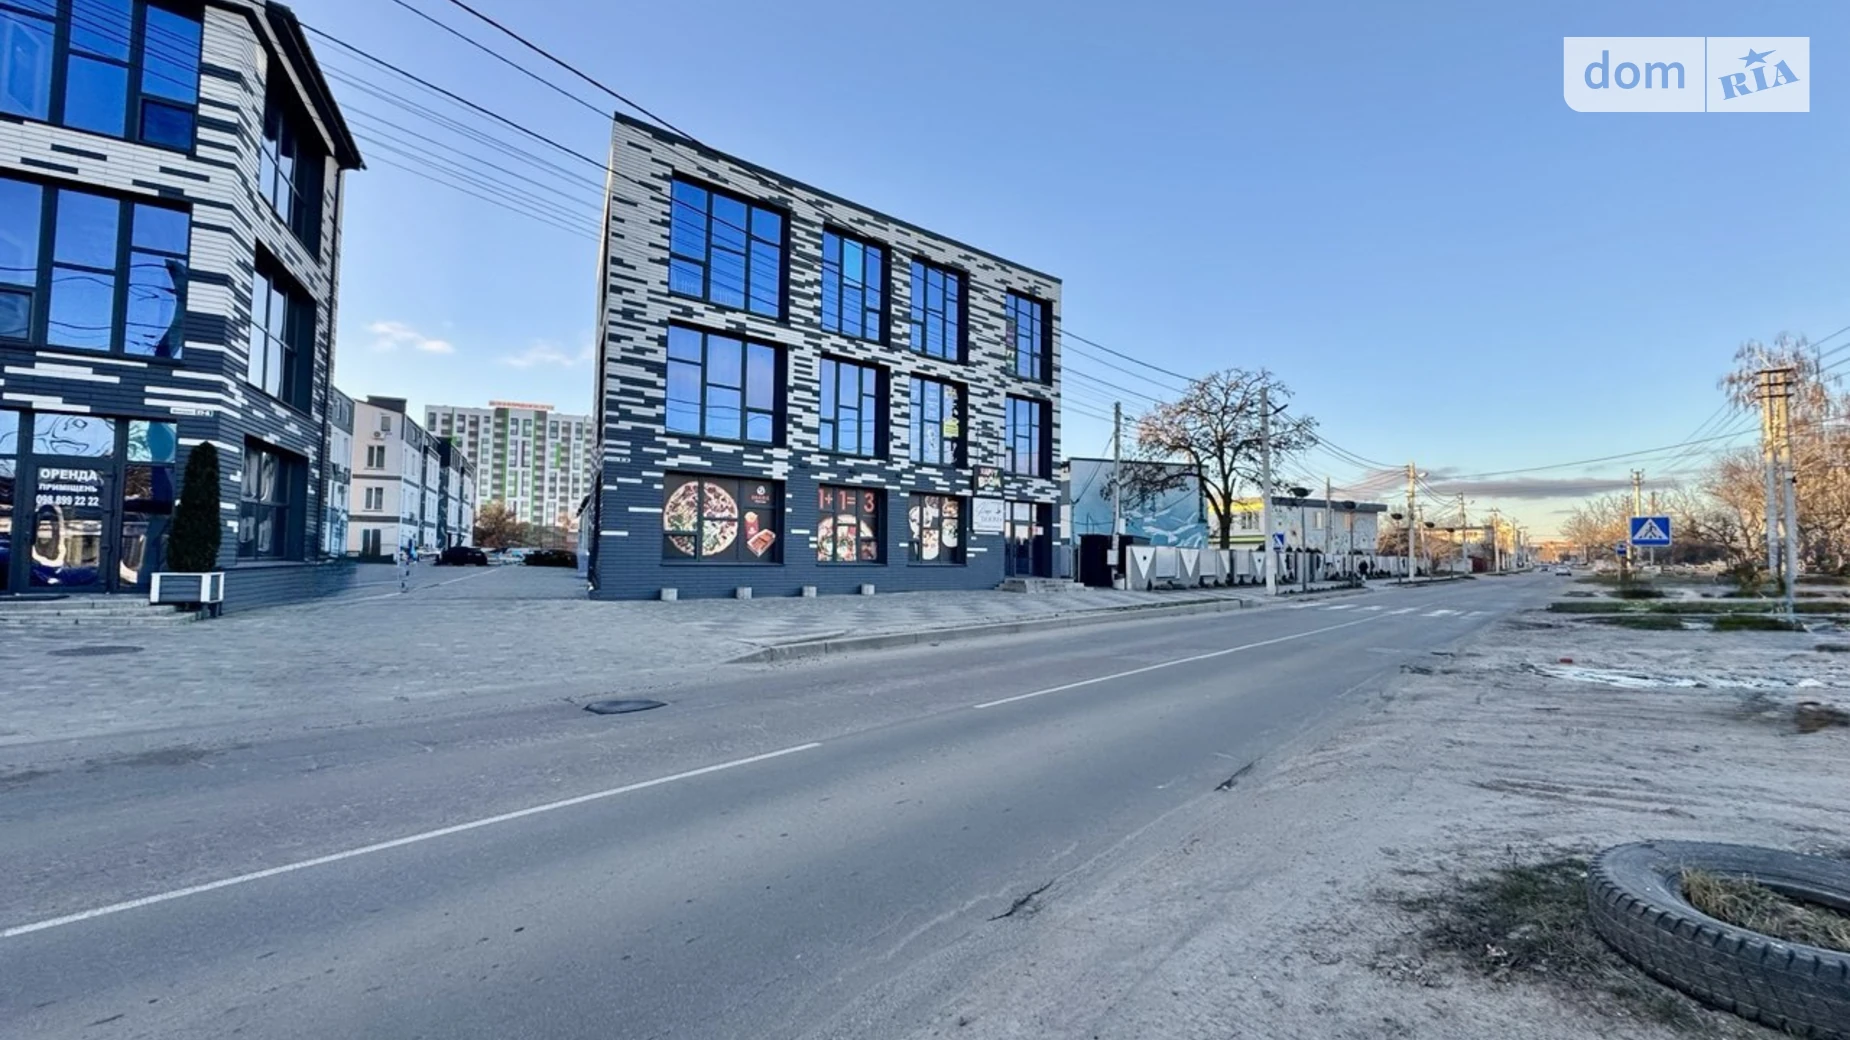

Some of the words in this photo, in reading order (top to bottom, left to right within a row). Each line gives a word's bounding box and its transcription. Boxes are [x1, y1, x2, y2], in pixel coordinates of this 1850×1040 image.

[40, 468, 97, 482] ОРЕНДА
[39, 483, 98, 493] ПРИМІЩЕНЬ
[74, 496, 86, 506] 22
[87, 496, 99, 507] 22
[864, 493, 875, 513] 3
